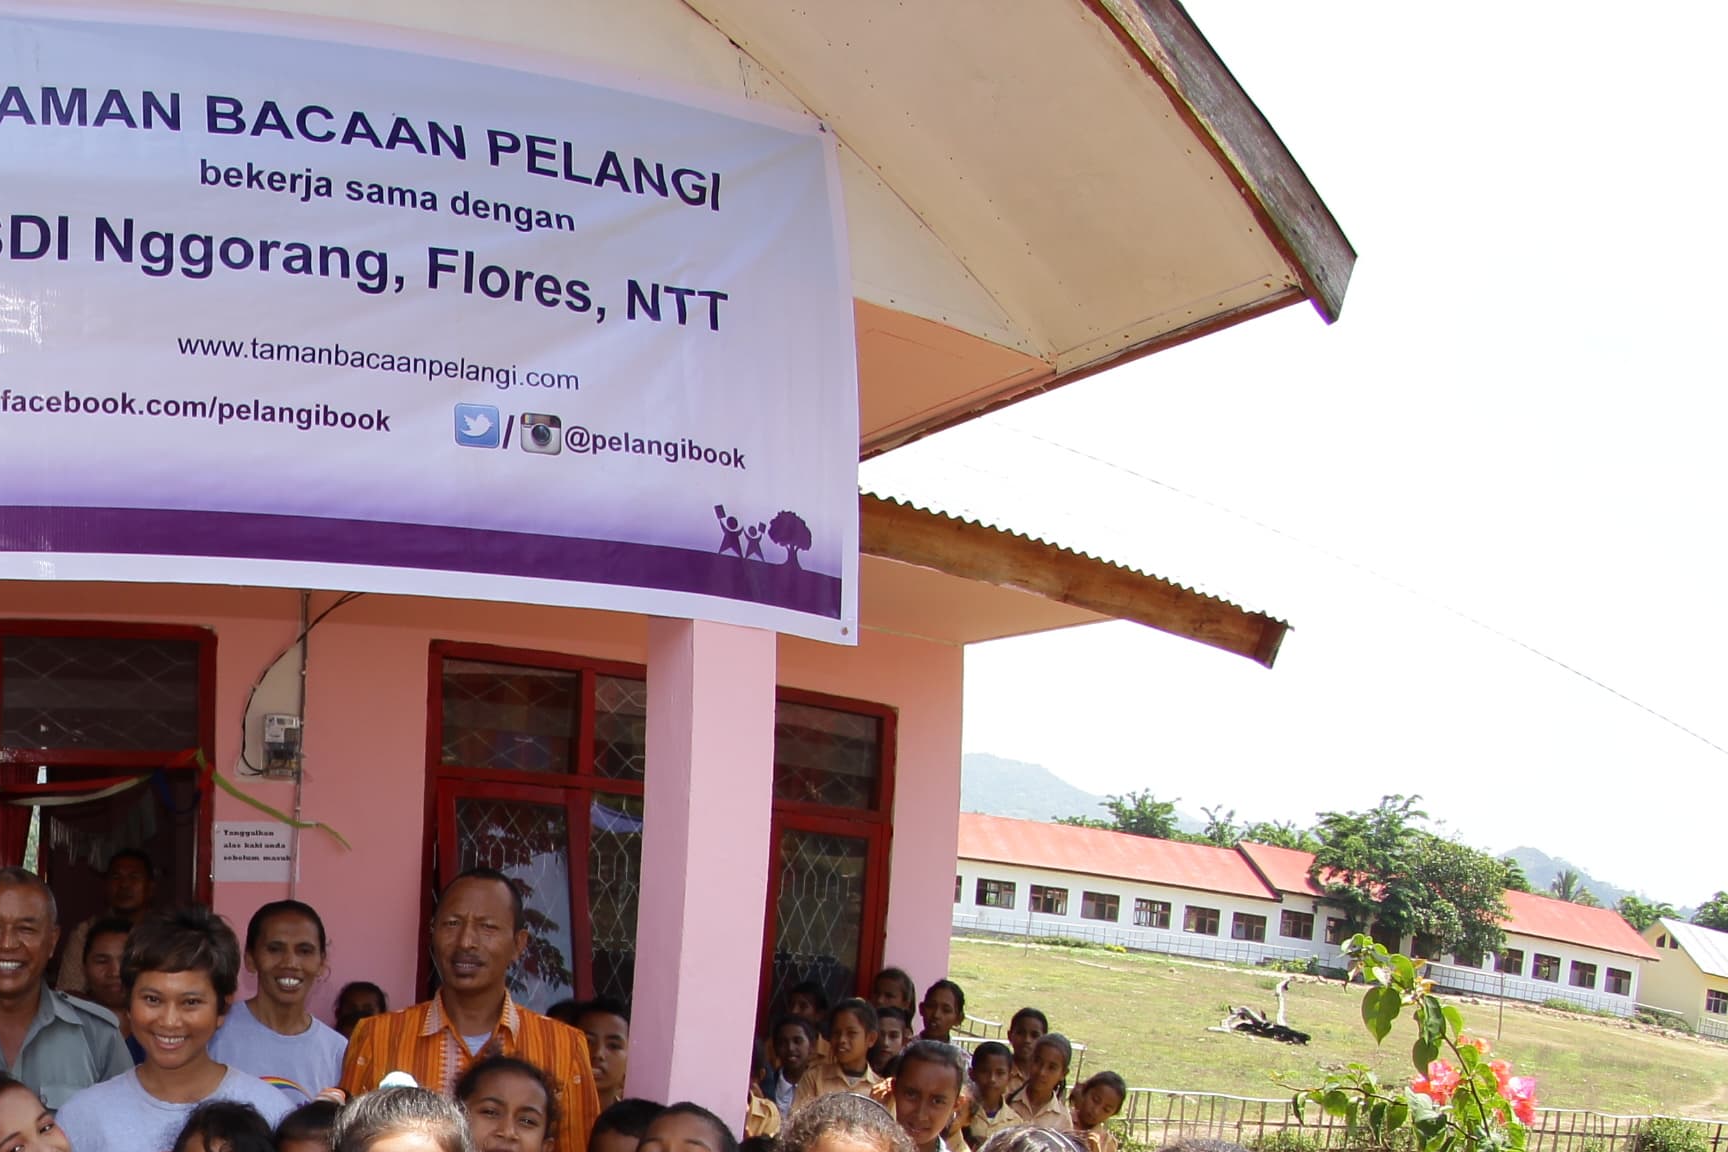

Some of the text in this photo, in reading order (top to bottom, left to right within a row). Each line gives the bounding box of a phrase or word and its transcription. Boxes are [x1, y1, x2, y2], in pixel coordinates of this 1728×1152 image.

[205, 94, 468, 161] BACAAN
[486, 128, 721, 212] PELANGI
[199, 158, 576, 234] bekerja sama dengan
[93, 216, 406, 295] Nggorang,
[426, 246, 607, 325] Flores,
[625, 278, 729, 332] NTT
[176, 336, 580, 392] www.tamanbacaanpelangi.com
[0, 388, 392, 433] facebook.com/pelangibook
[564, 424, 747, 470] @pelangibook
[223, 829, 275, 838] Tanggalkan
